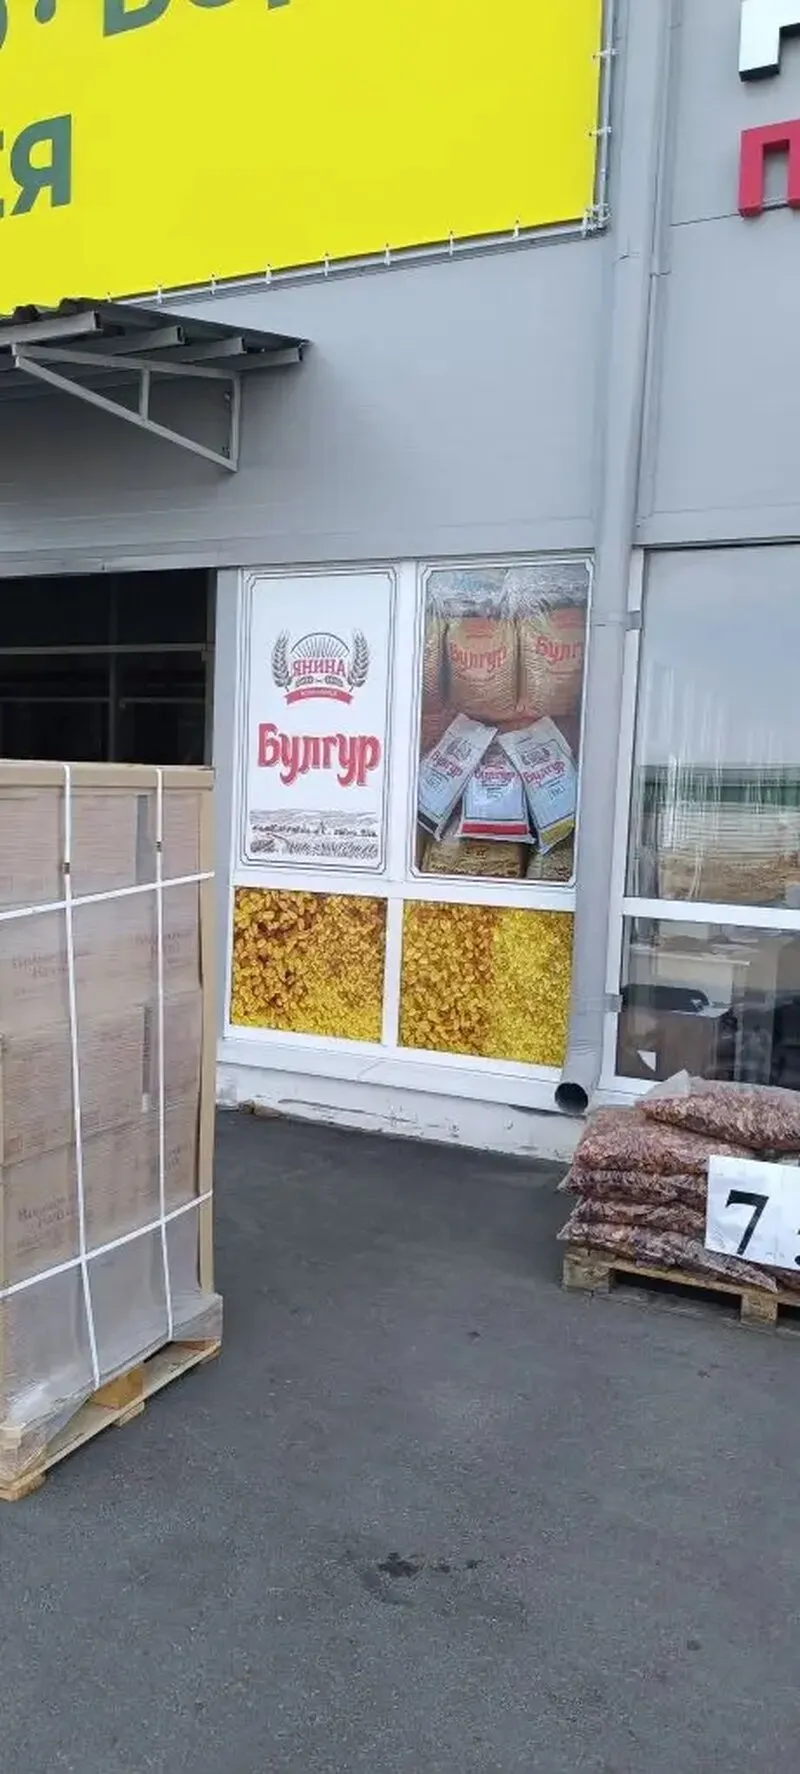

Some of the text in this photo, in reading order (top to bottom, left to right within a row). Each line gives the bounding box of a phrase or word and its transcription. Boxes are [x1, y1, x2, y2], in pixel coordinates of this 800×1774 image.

[0, 114, 72, 219] Я
[292, 659, 347, 678] ЯНИНА
[258, 723, 382, 787] Булгур
